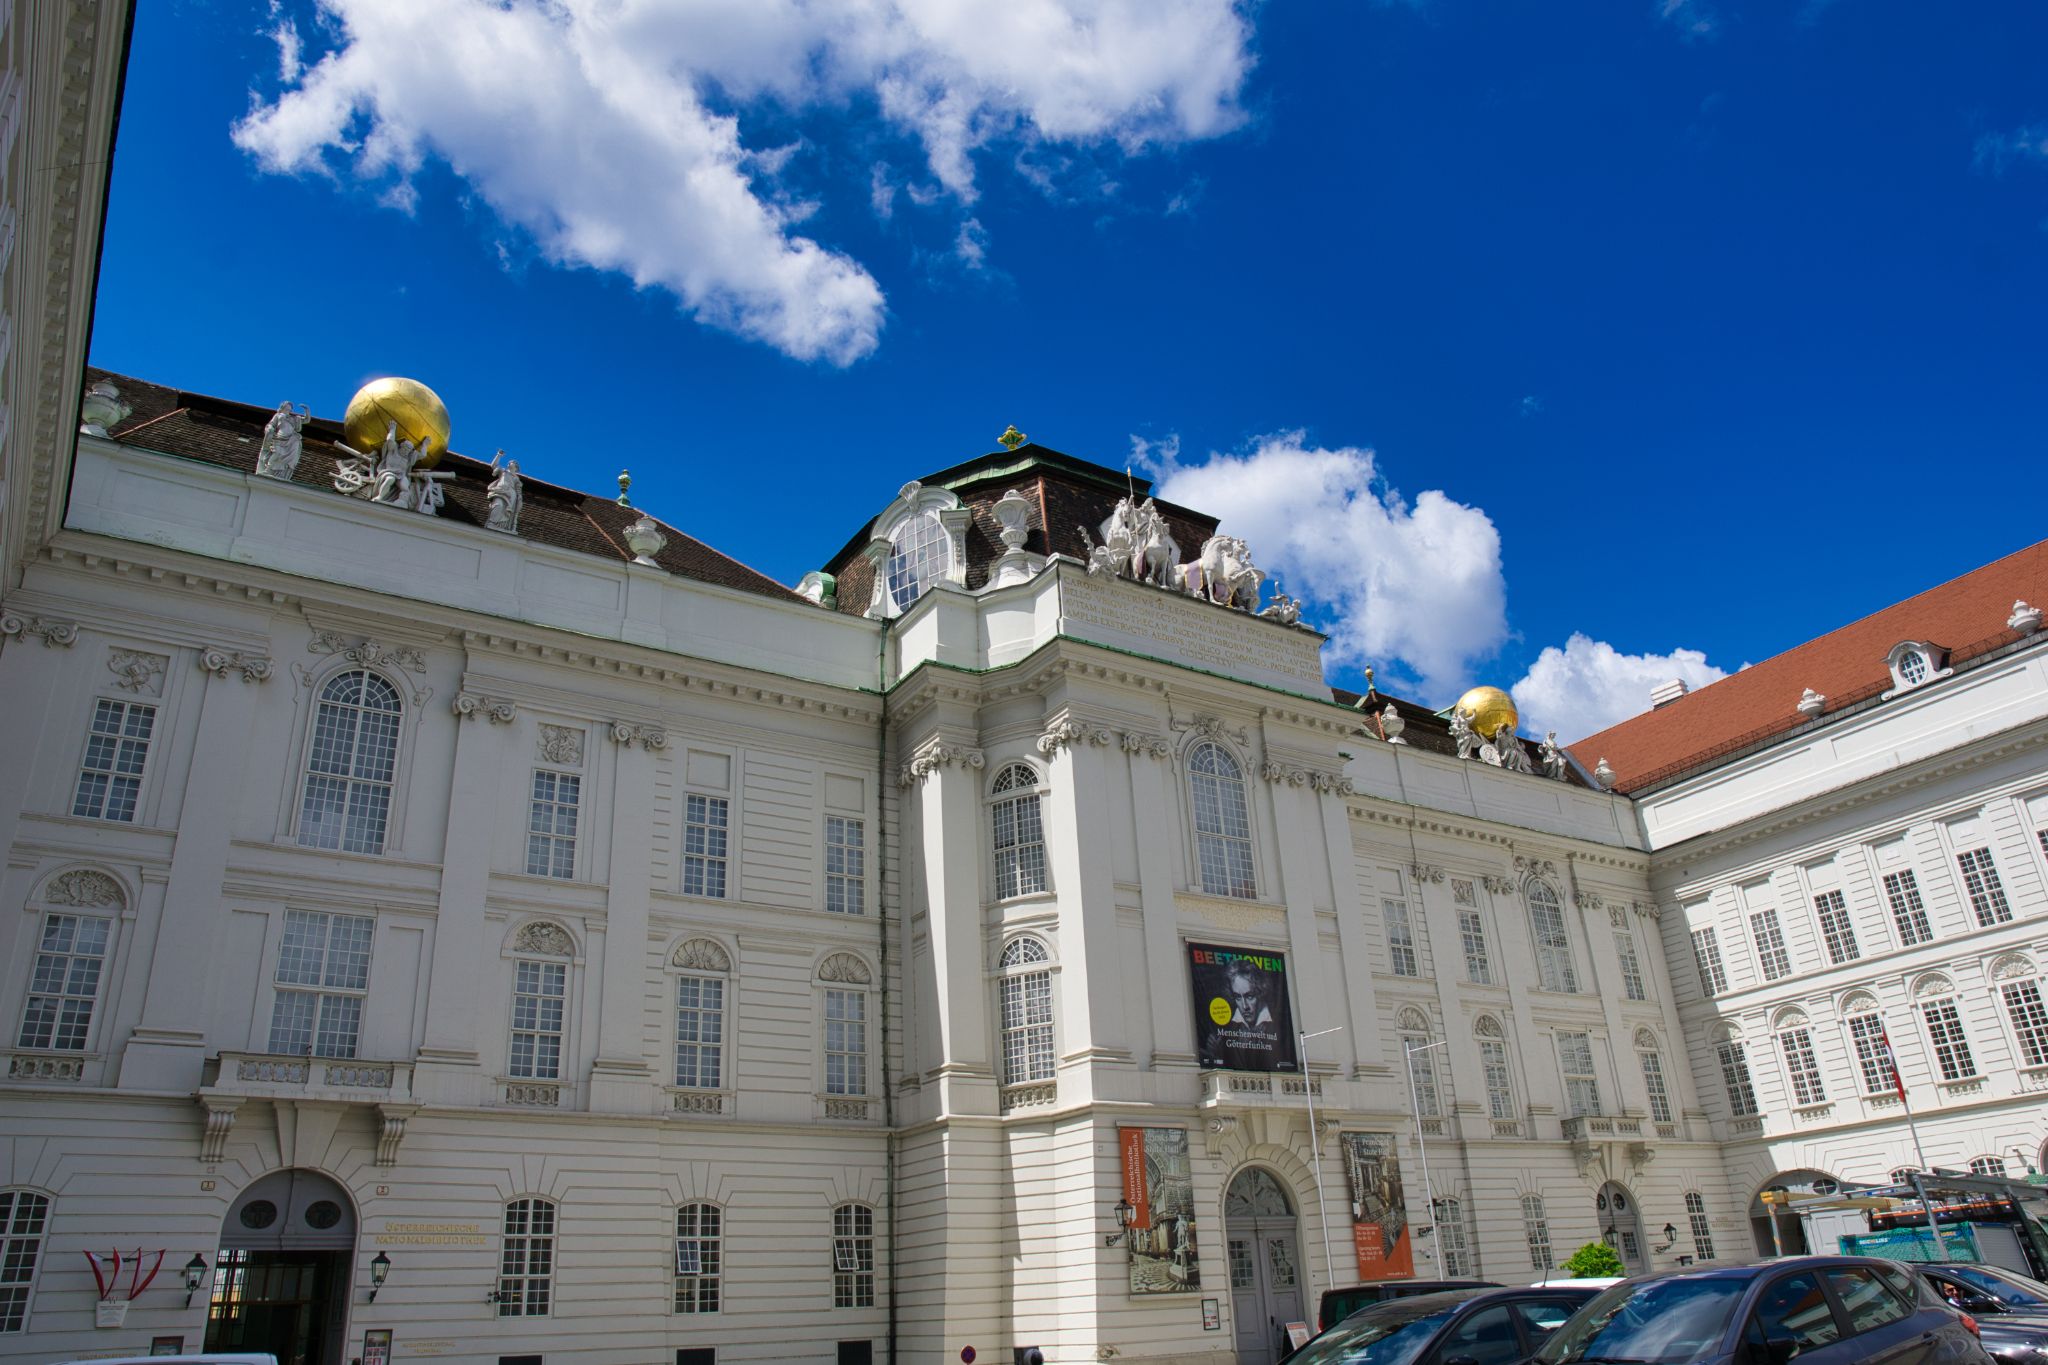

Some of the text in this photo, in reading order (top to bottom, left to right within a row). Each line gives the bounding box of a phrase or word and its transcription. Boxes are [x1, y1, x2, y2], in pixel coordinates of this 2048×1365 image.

[1218, 1028, 1278, 1041] Menschenwelt und
[1226, 1039, 1272, 1050] Götterfunken
[1128, 1146, 1136, 1204] Österreichische
[1132, 1134, 1142, 1204] Nationalbibliothek
[375, 1236, 487, 1246] NATIONALBIBLIOTHEK
